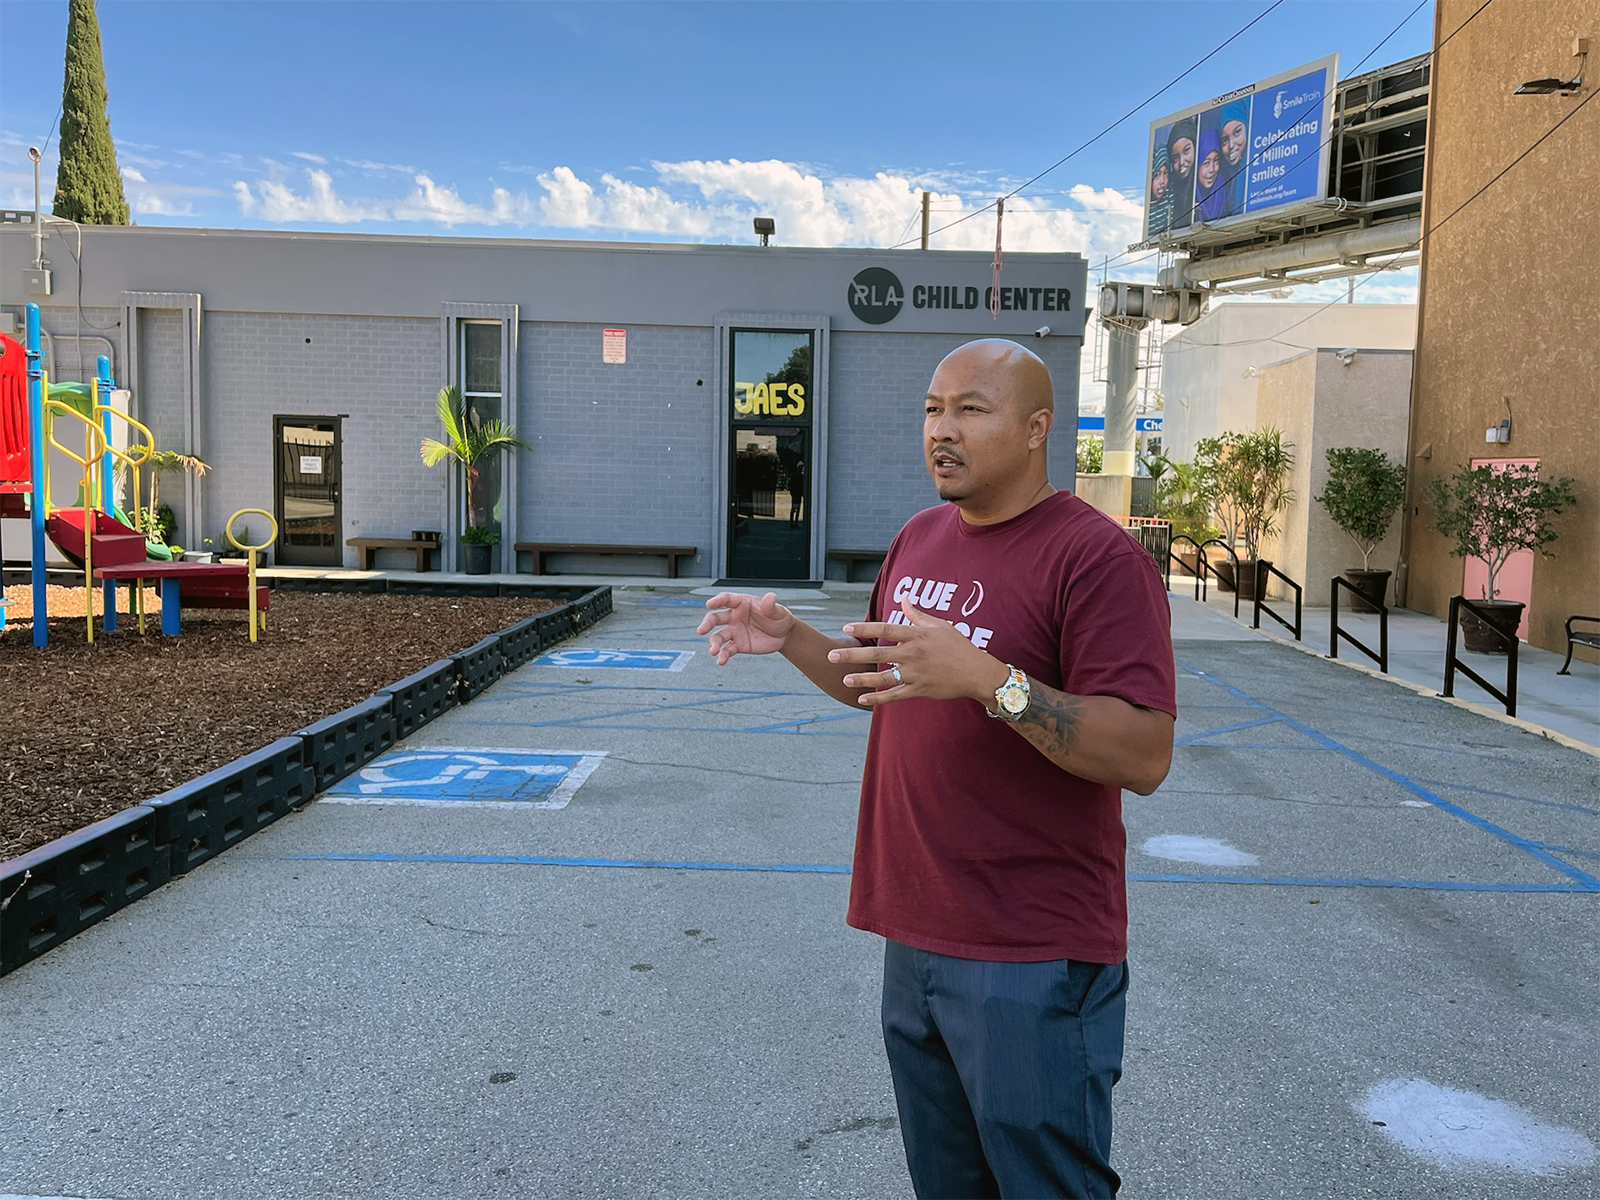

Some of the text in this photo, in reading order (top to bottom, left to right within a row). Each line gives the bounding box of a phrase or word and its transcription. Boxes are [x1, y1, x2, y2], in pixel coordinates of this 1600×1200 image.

[1254, 120, 1318, 148] Celebrating
[1262, 144, 1298, 163] Million
[1251, 165, 1285, 183] smiles
[854, 284, 1071, 311] RLA CHILD CENTER
[735, 382, 805, 416] JAES
[893, 576, 958, 611] CLUE
